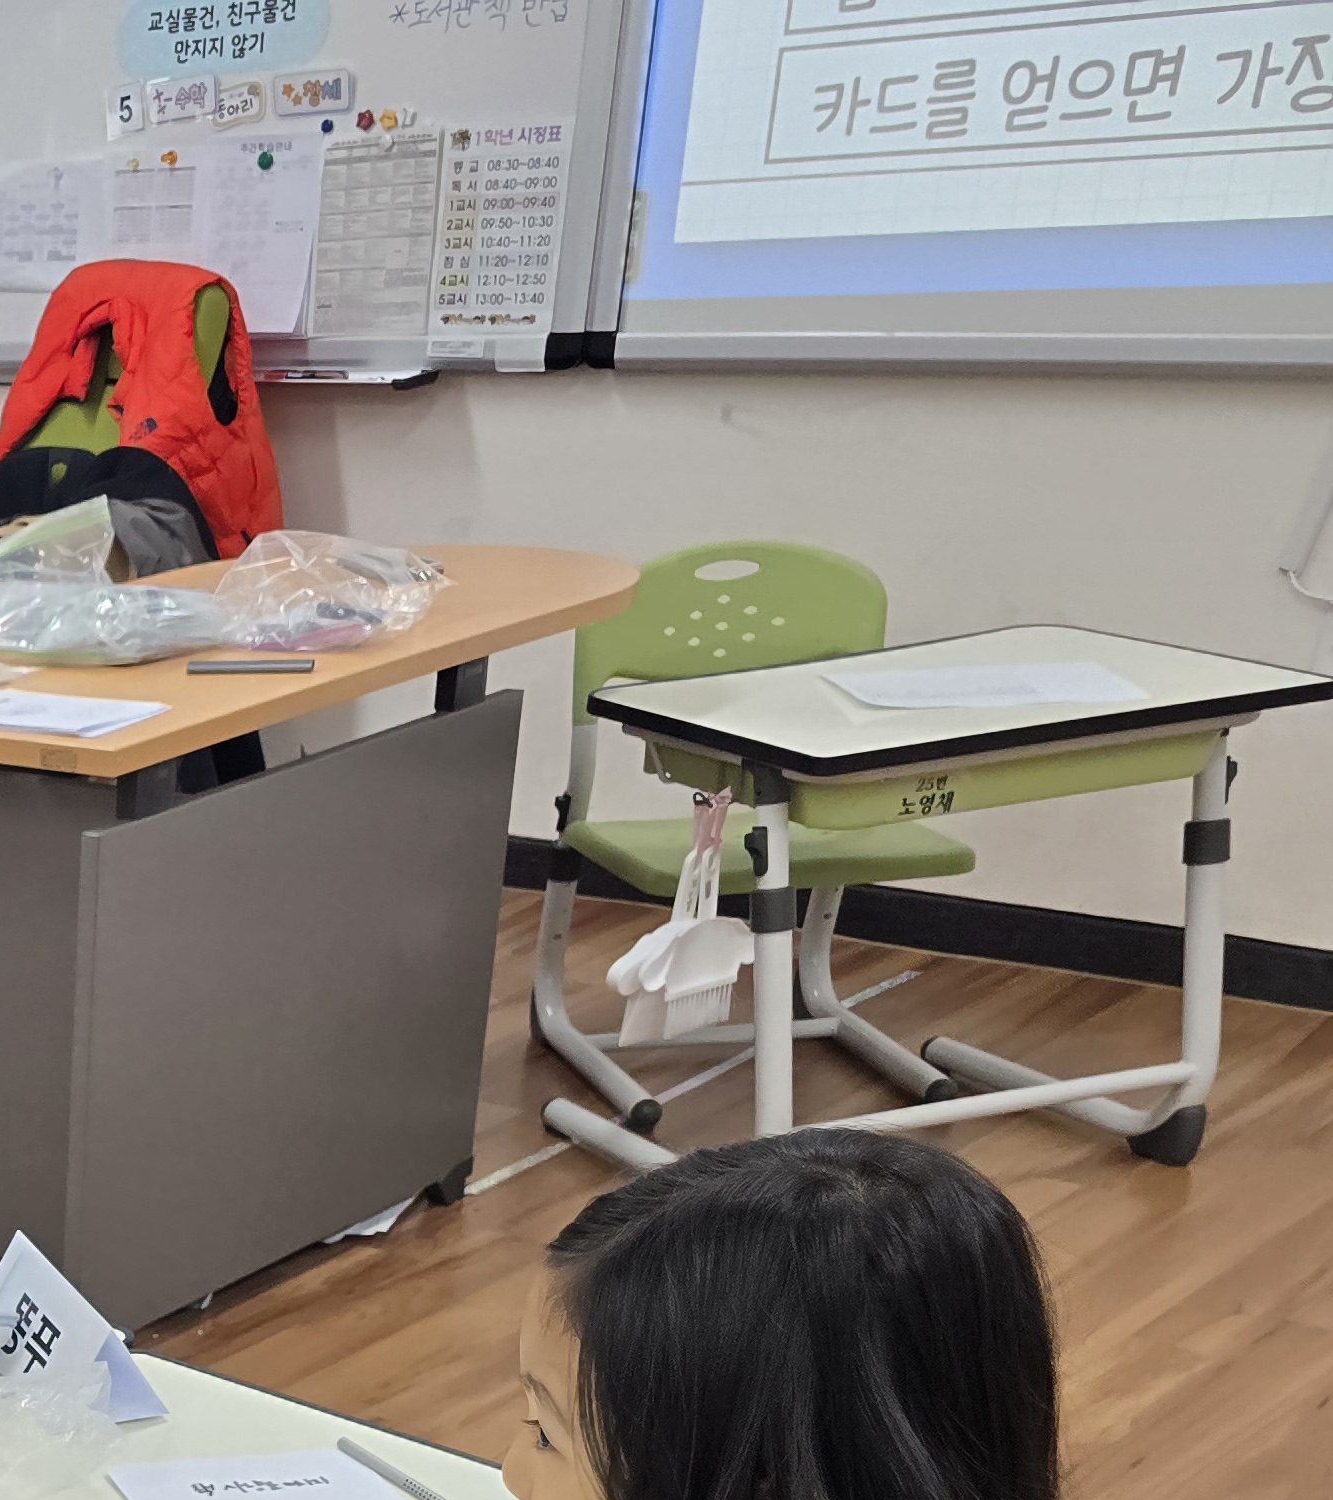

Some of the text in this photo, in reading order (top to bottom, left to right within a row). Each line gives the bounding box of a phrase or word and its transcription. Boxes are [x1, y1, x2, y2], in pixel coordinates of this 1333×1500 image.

[147, 0, 297, 34] 교실물건, 친구물건
[174, 32, 266, 64] 만지지 않기
[813, 57, 977, 140] 카드를
[1001, 45, 1186, 132] 얻으면
[118, 94, 133, 124] 5
[476, 125, 563, 147] 1학년 시정표
[484, 176, 558, 192] 08:40~09:00
[449, 198, 477, 212] 1교시
[446, 217, 475, 231] 2교시
[444, 236, 474, 250] 3교시
[439, 274, 470, 287] 4교시
[438, 293, 468, 306] 5교시
